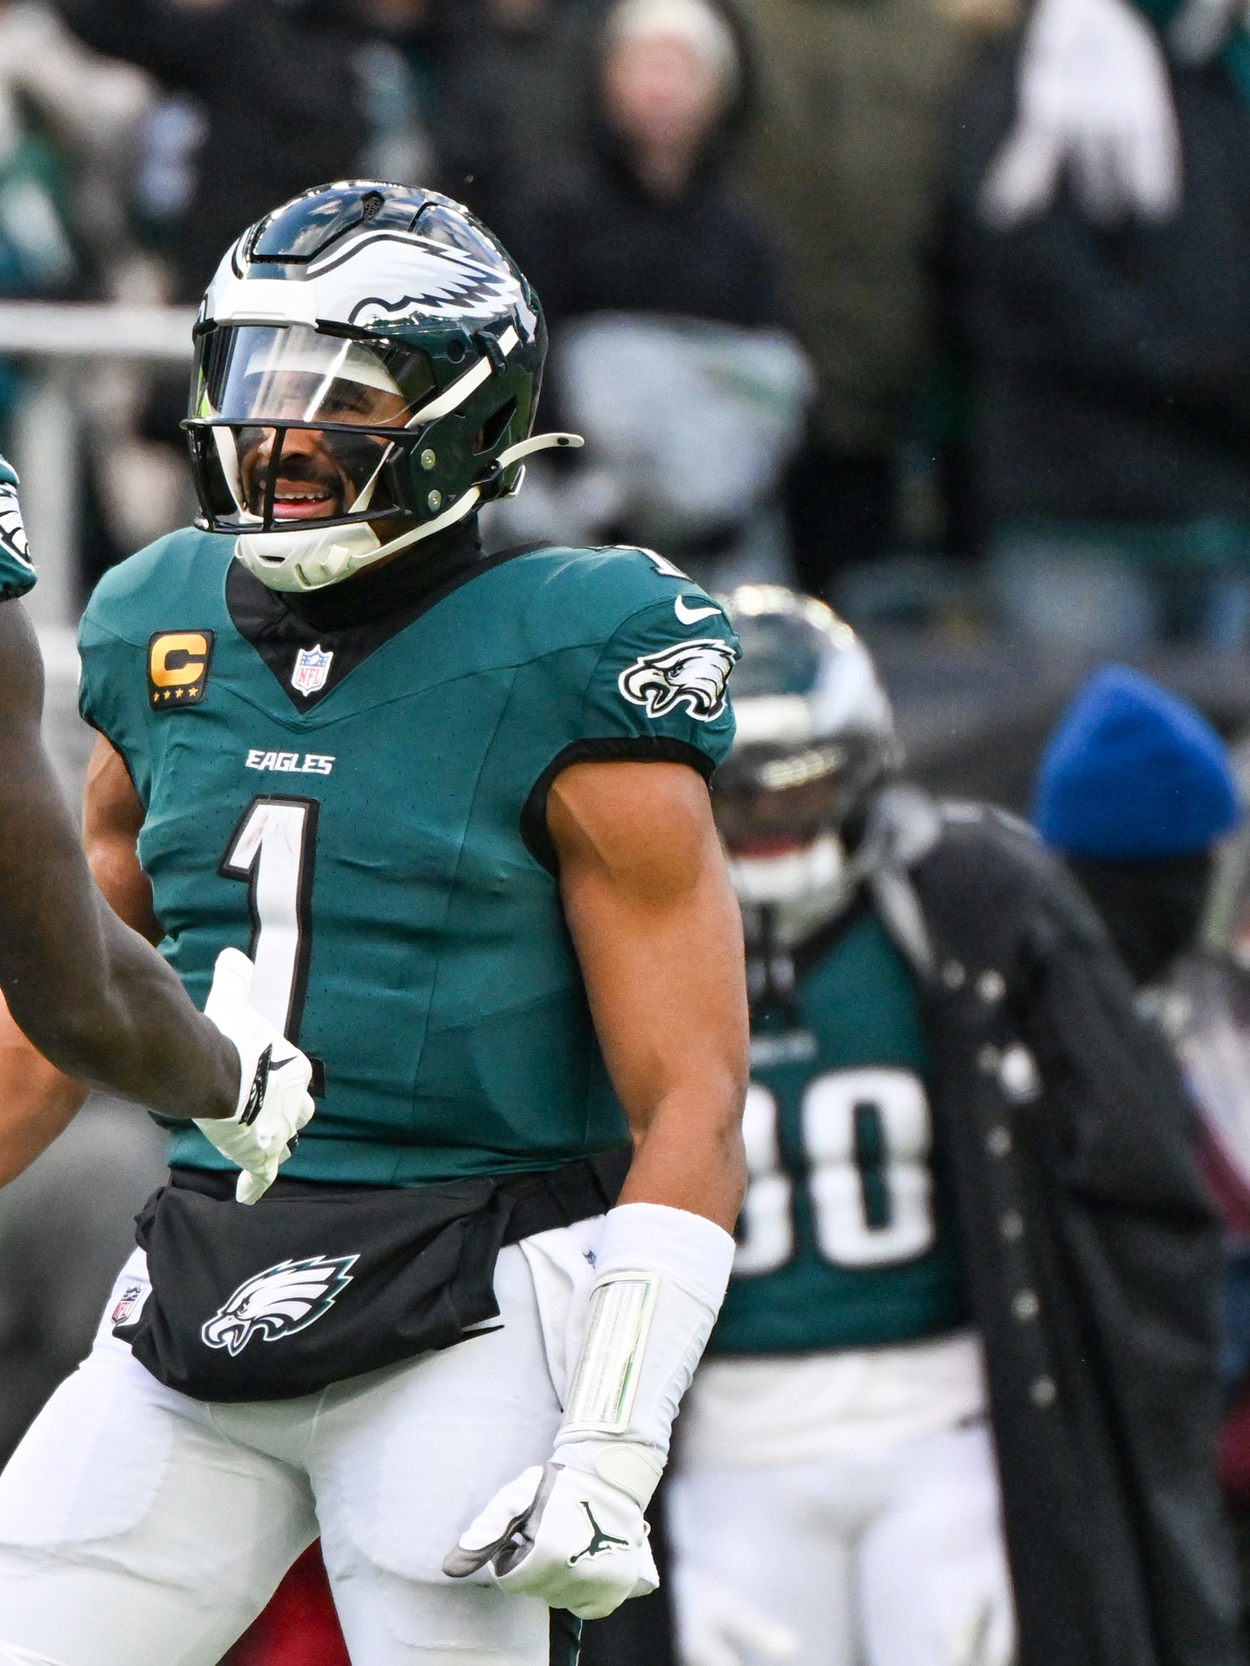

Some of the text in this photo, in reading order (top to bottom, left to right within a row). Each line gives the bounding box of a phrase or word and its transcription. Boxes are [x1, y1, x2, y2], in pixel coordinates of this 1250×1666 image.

[151, 633, 208, 688] C
[299, 667, 321, 685] NFL
[245, 749, 336, 775] EAGLES
[220, 796, 323, 1092] 1
